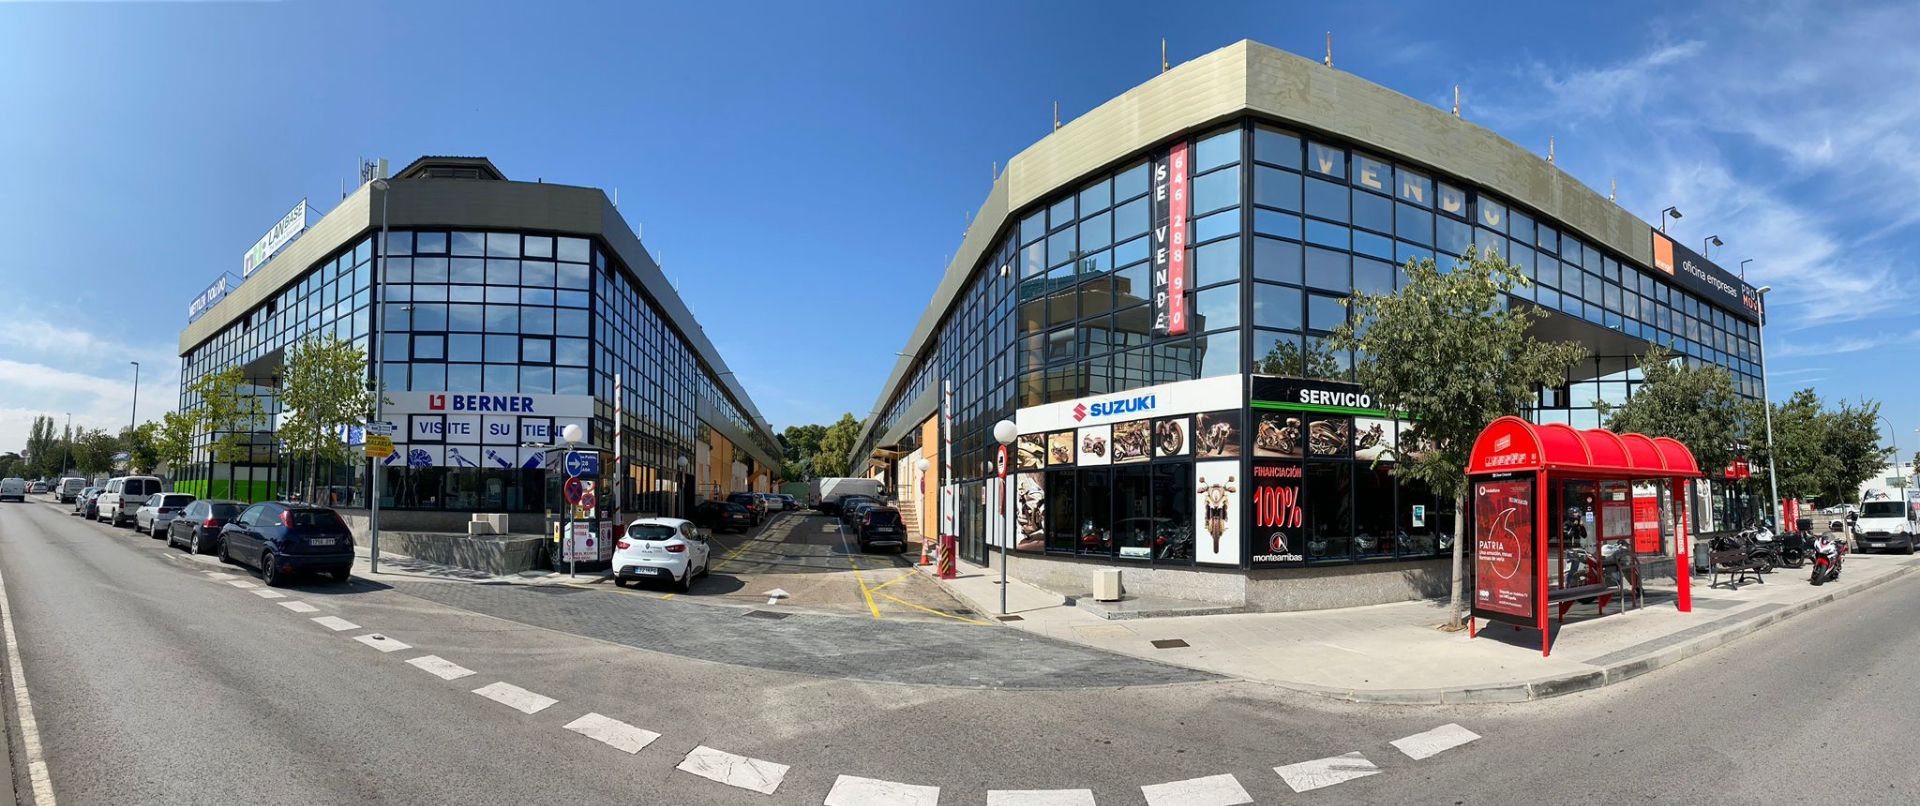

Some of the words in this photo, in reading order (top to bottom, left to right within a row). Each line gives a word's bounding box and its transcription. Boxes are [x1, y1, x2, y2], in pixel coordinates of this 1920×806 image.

[1157, 165, 1167, 202] SE
[1155, 226, 1167, 330] VENDE
[1682, 260, 1706, 282] oficina
[1707, 274, 1738, 298] empresas
[453, 395, 534, 413] BERNER
[1091, 395, 1156, 416] SUZUKI
[1300, 389, 1370, 408] SERVICIO
[420, 422, 470, 435] VISITE
[490, 424, 510, 436] SU
[1254, 465, 1302, 478] FINANCIACIÓN
[1253, 485, 1303, 528] 100%
[1479, 541, 1504, 551] PATRIA
